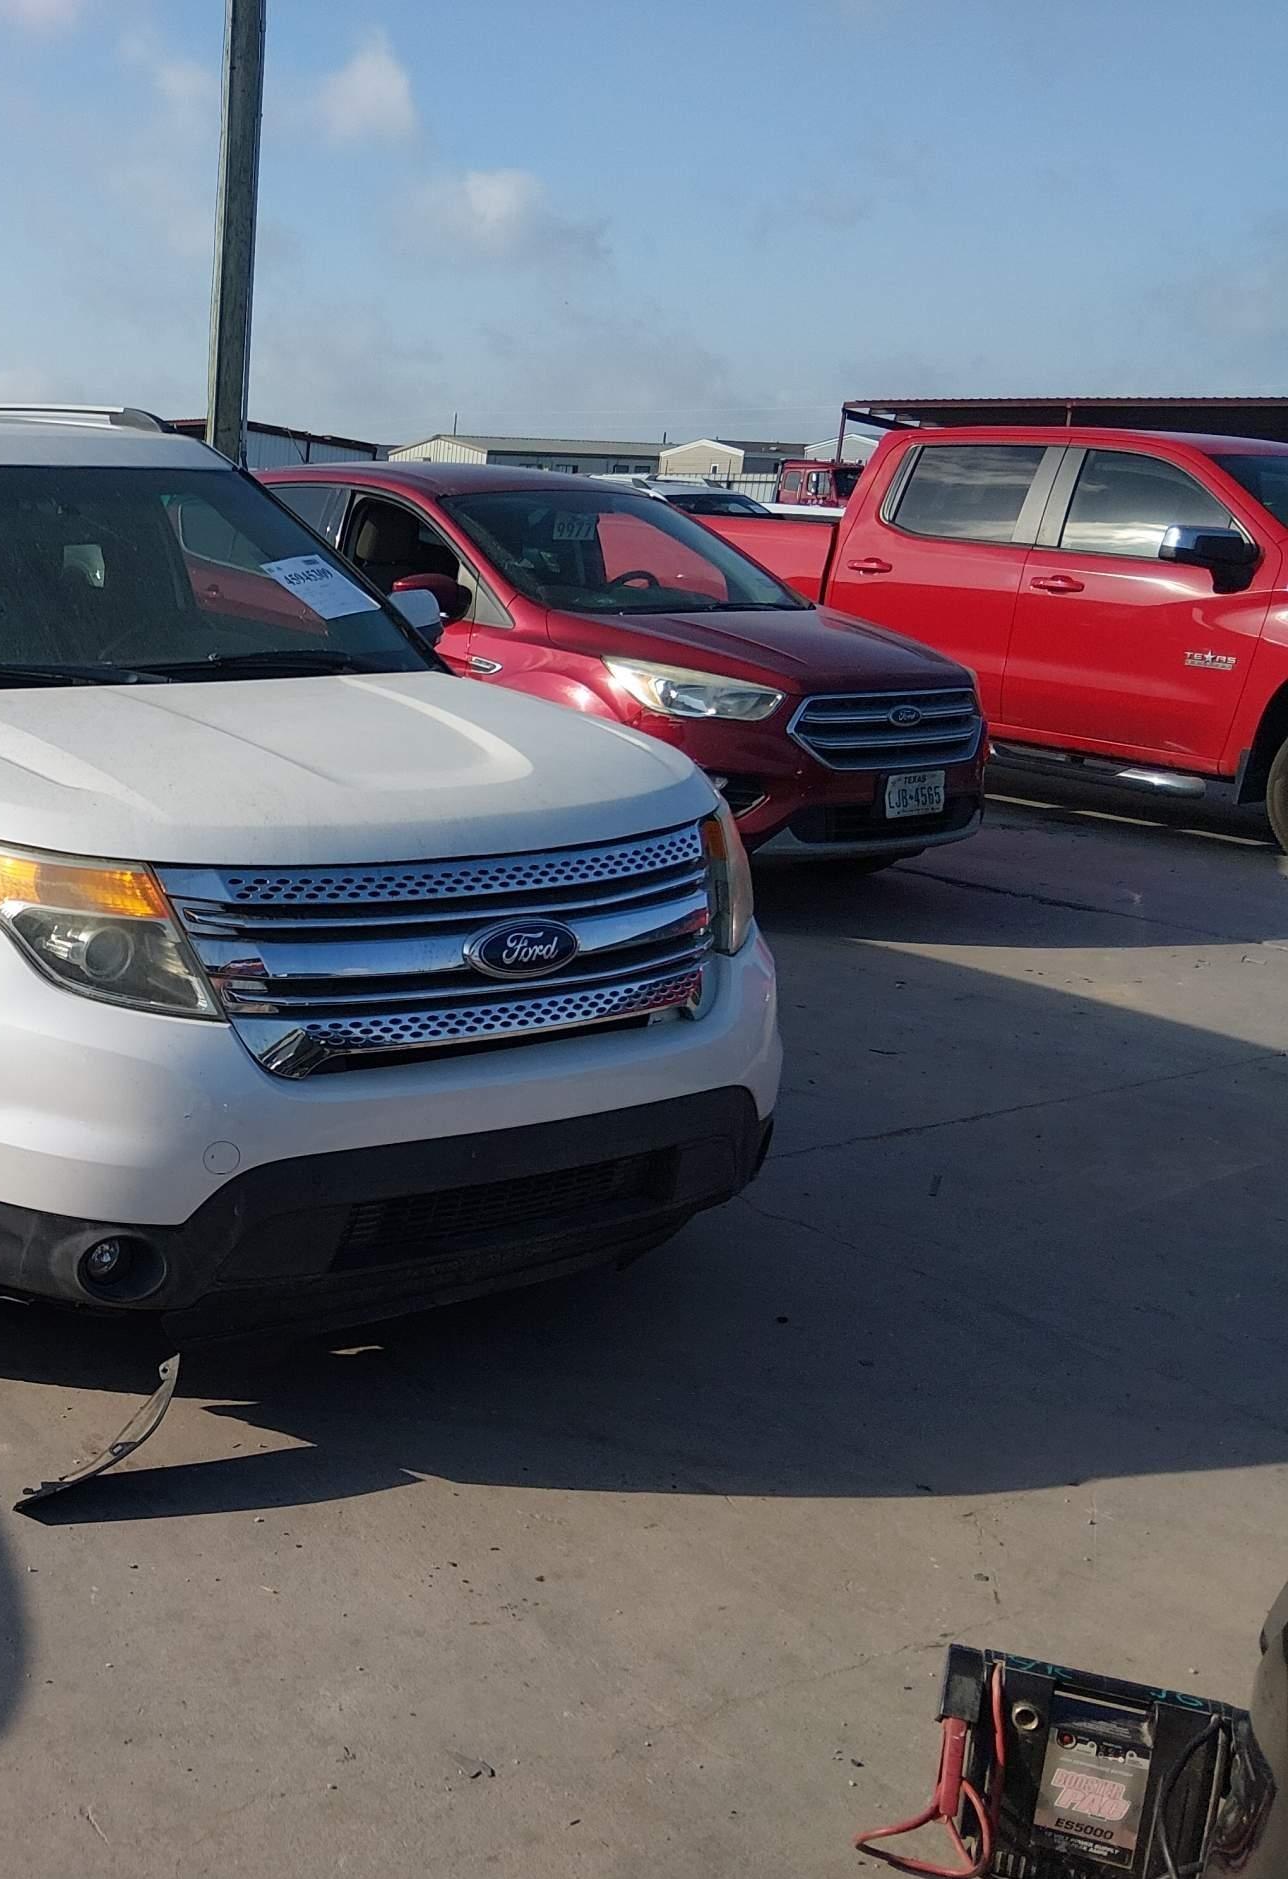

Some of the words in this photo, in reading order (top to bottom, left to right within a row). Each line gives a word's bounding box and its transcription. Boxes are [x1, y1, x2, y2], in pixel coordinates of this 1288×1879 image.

[903, 775, 928, 785] TEXAS
[502, 931, 559, 964] Ford
[1054, 1817, 1114, 1840] ES5000
